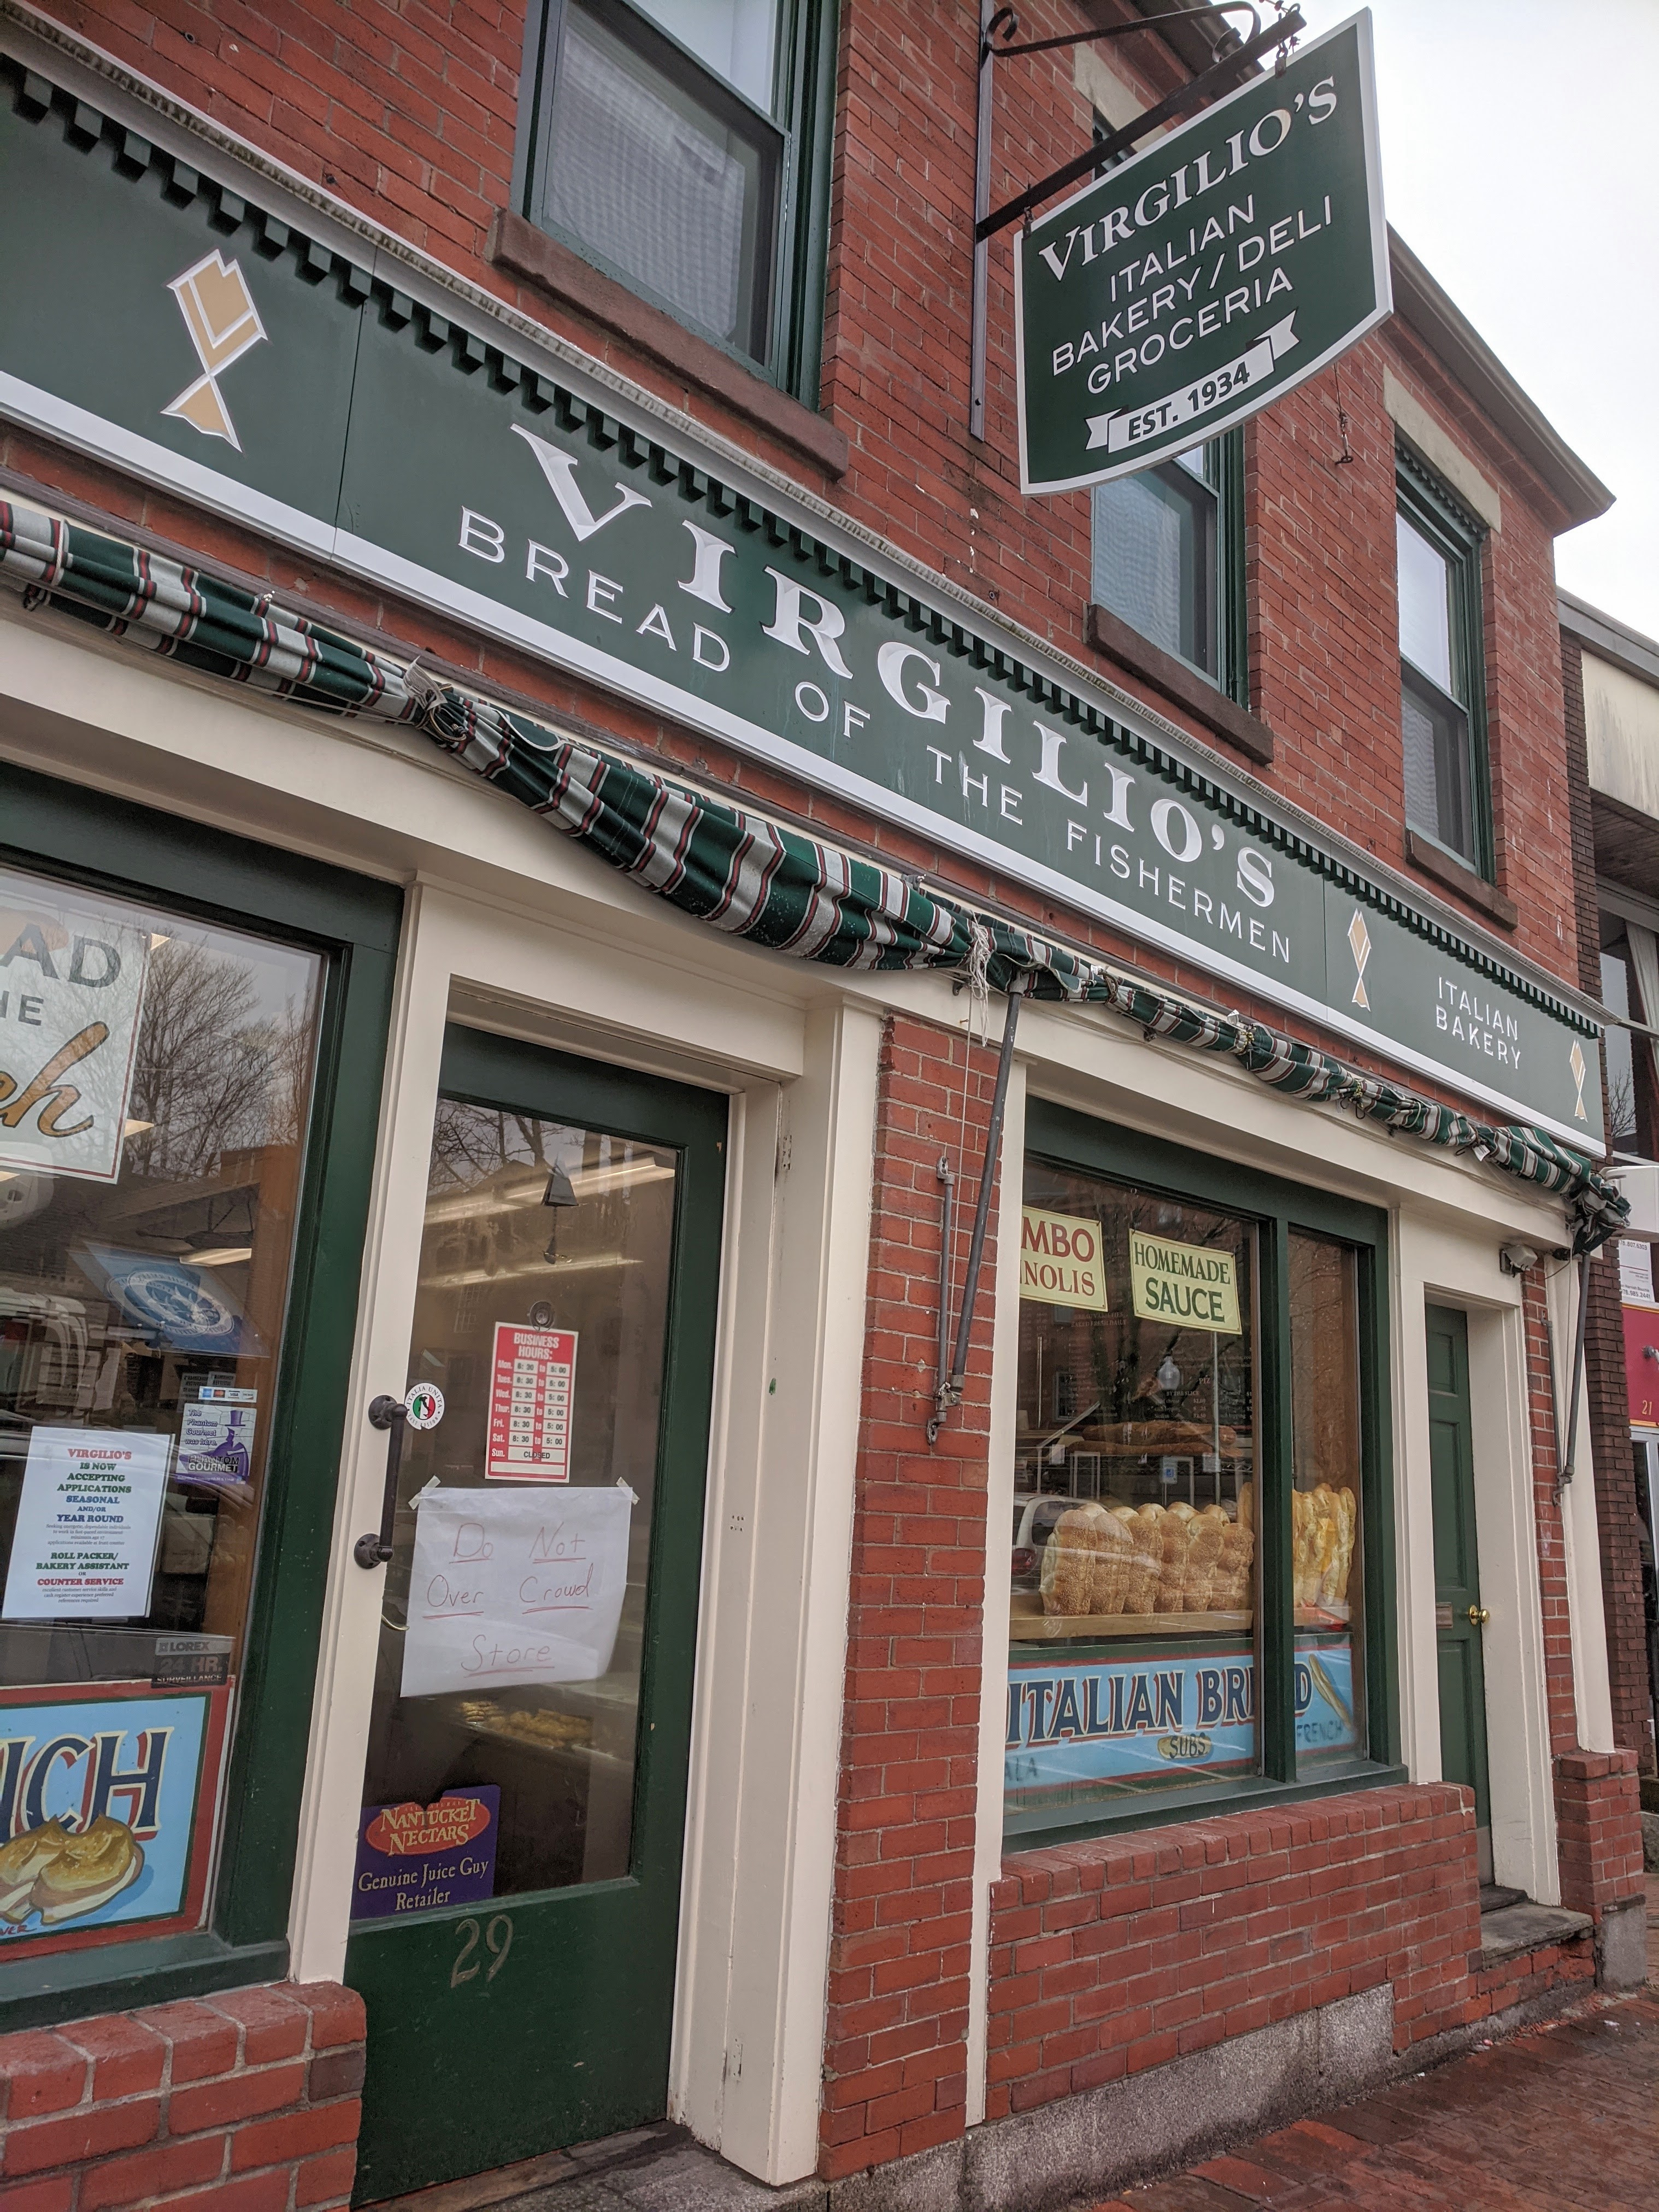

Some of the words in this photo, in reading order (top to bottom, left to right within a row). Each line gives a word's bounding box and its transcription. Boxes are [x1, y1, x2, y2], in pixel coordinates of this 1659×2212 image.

[1039, 77, 1338, 281] VIRGILIO'S
[1238, 195, 1332, 273] DELI
[1111, 194, 1255, 303] ITALIAN
[1087, 268, 1295, 393] GROCERIA
[1128, 405, 1178, 442] EST.
[1187, 361, 1250, 419] 1934
[510, 423, 1275, 908] VIRGILIO'S
[458, 505, 731, 672] BREAD
[795, 681, 870, 739] OF
[926, 745, 1023, 825] THE
[1067, 819, 1290, 963] FISHERMEN
[1438, 976, 1518, 1042] ITALIAN
[1436, 1004, 1521, 1070] BAKERY
[1134, 1242, 1231, 1285] HOMEMADE
[1020, 1259, 1095, 1296] NOLIS
[1145, 1276, 1225, 1323] SAUCE
[514, 1332, 560, 1349] BUSINESS
[519, 1345, 553, 1360] HOURS:
[498, 1360, 513, 1369] Mon.
[497, 1374, 512, 1383] Tues.
[407, 1386, 426, 1405] ITALIA
[428, 1386, 443, 1408] UNITA
[496, 1389, 510, 1398] Wed.
[495, 1404, 510, 1413] Thur.
[1642, 1399, 1652, 1415] 21
[186, 1419, 218, 1427] Phantom
[186, 1428, 217, 1436] Gourmet
[493, 1419, 504, 1427] Fri.
[493, 1433, 505, 1443] Sat.
[535, 1437, 541, 1445] to
[68, 1449, 132, 1460] VIRGILIO'S
[189, 1455, 239, 1464] PHANTOM
[492, 1448, 505, 1457] Sun.
[523, 1451, 551, 1459] CLOSED
[67, 1473, 125, 1482] ACCEPTING
[92, 1463, 116, 1471] NOW
[188, 1462, 238, 1473] GOURMET
[57, 1484, 132, 1493] APPLICATIONS
[66, 1495, 120, 1504] SEASONAL
[57, 1514, 85, 1522] YEAR
[87, 1515, 124, 1523] ROUND
[453, 1522, 493, 1557] Do
[529, 1522, 586, 1557] Not
[77, 1552, 119, 1561] PACKER/
[427, 1574, 484, 1607] Over
[519, 1563, 594, 1603] Crowd
[170, 1641, 209, 1651] LOREX
[461, 1634, 552, 1672] Store
[1005, 1669, 1185, 1746] ITALIAN
[1296, 1720, 1343, 1743] FRENCH
[1169, 1732, 1208, 1759] SUBS
[380, 1798, 480, 1832] NANTUCKET
[387, 1824, 469, 1857] NECTARS
[358, 1868, 418, 1892] Genuine
[421, 1863, 456, 1889] Juice
[460, 1857, 489, 1879] Guy
[395, 1886, 451, 1911] Retailer
[450, 1915, 514, 1989] 29
